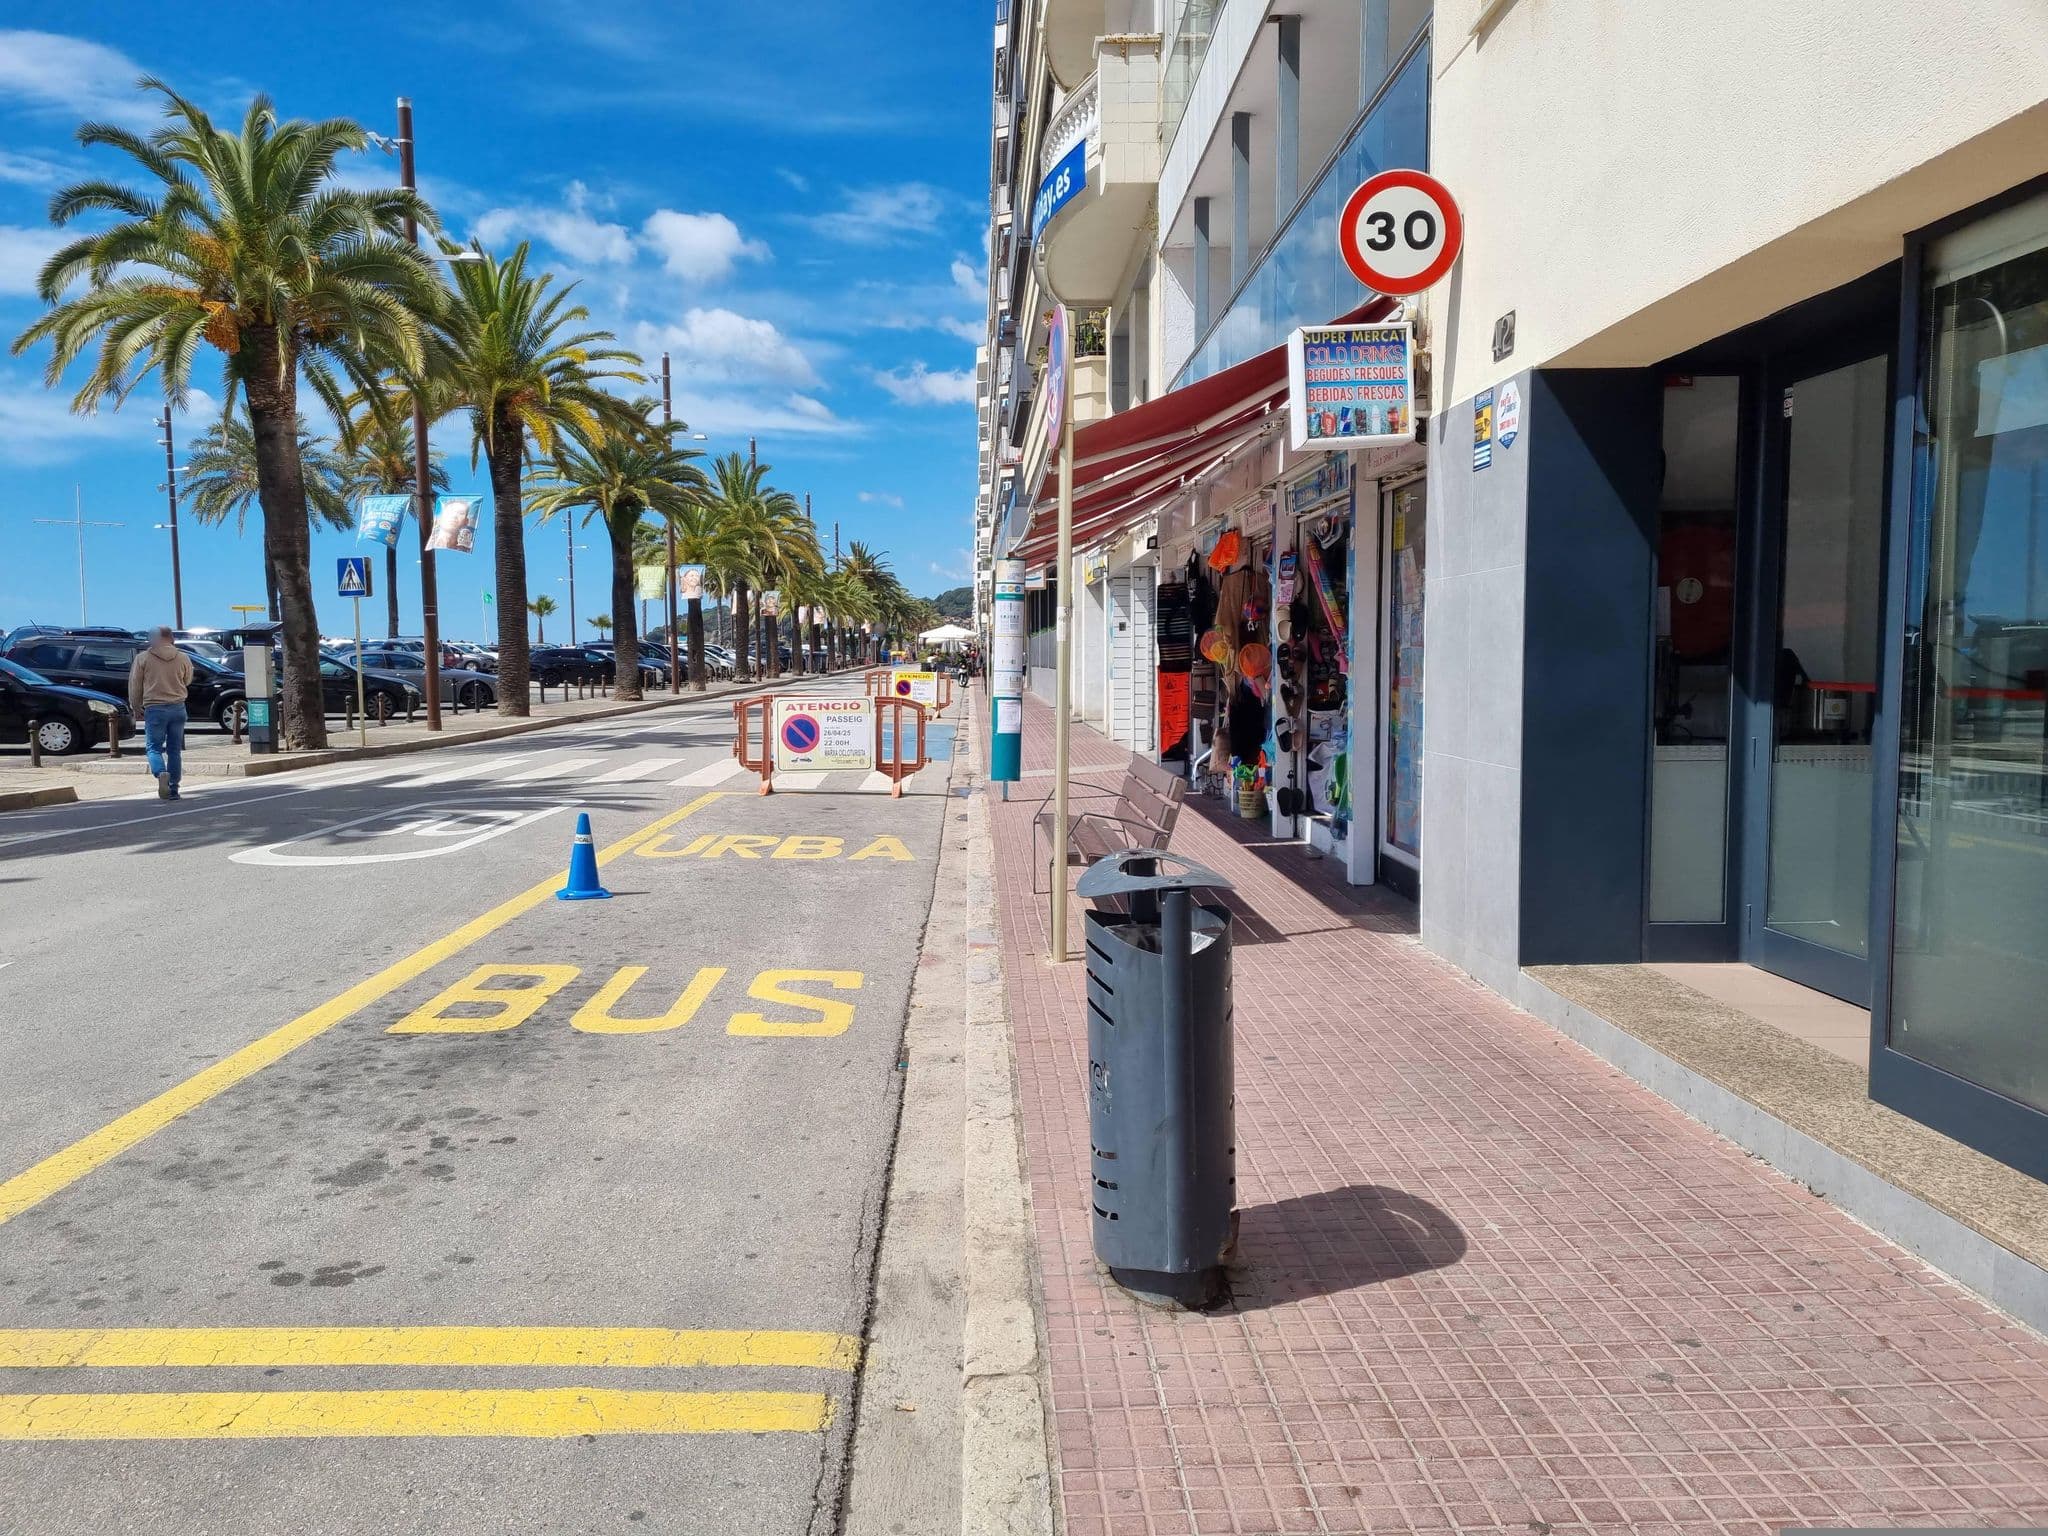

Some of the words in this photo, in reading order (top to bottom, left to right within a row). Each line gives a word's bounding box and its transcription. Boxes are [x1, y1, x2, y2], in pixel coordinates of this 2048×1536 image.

[1366, 210, 1437, 251] 30
[1303, 331, 1346, 344] SUPER
[1351, 329, 1406, 343] MERCAT
[1492, 314, 1513, 357] 42
[1306, 346, 1348, 365] COLD
[1350, 345, 1404, 363] DRINKS
[1307, 368, 1351, 381] BEGUDES
[1354, 366, 1404, 380] FRESQUES
[1308, 387, 1354, 402] BEBIDAS
[1357, 385, 1405, 400] FRESCAS
[785, 701, 861, 711] ATENCIÓ
[826, 715, 863, 723] PASSEIG
[336, 810, 523, 837] 30
[384, 964, 865, 1037] BUS
